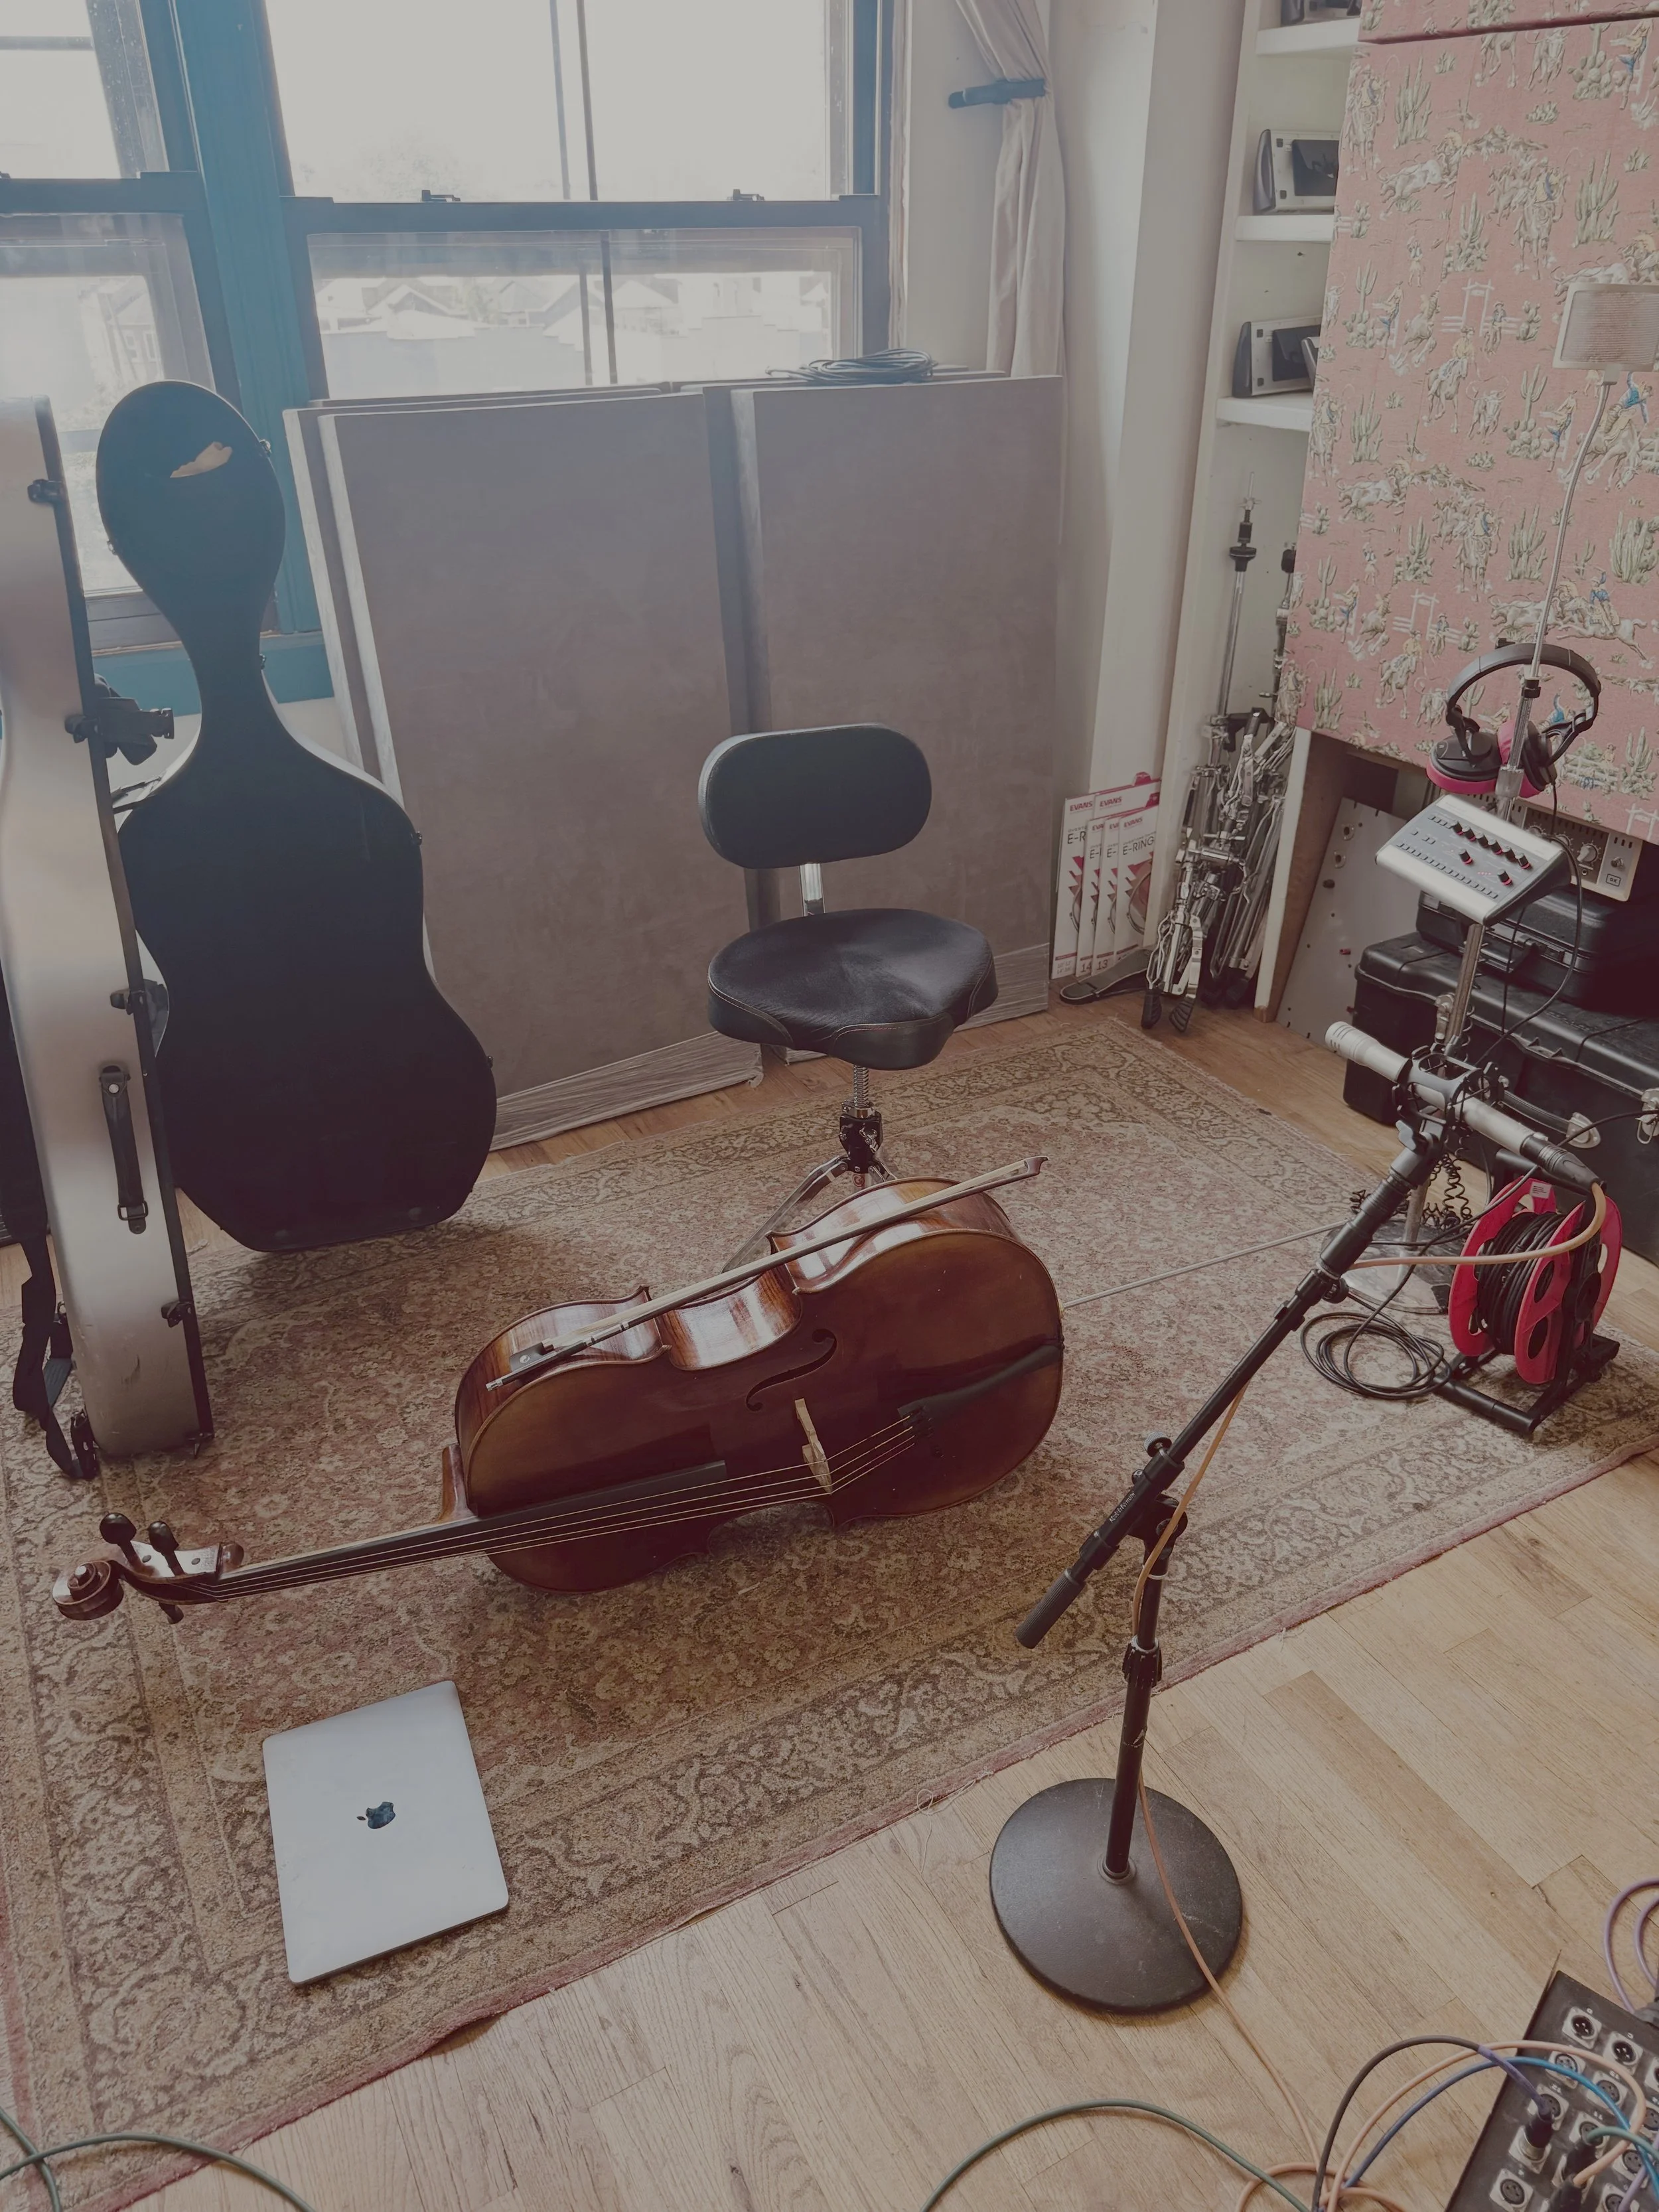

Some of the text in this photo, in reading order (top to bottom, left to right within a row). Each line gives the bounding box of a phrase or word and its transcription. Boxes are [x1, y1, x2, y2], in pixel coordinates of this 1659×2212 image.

[1070, 801, 1093, 812] EVANS
[1100, 796, 1122, 807] EVANS
[1123, 817, 1143, 828] EVANS
[1067, 831, 1086, 844] E-R
